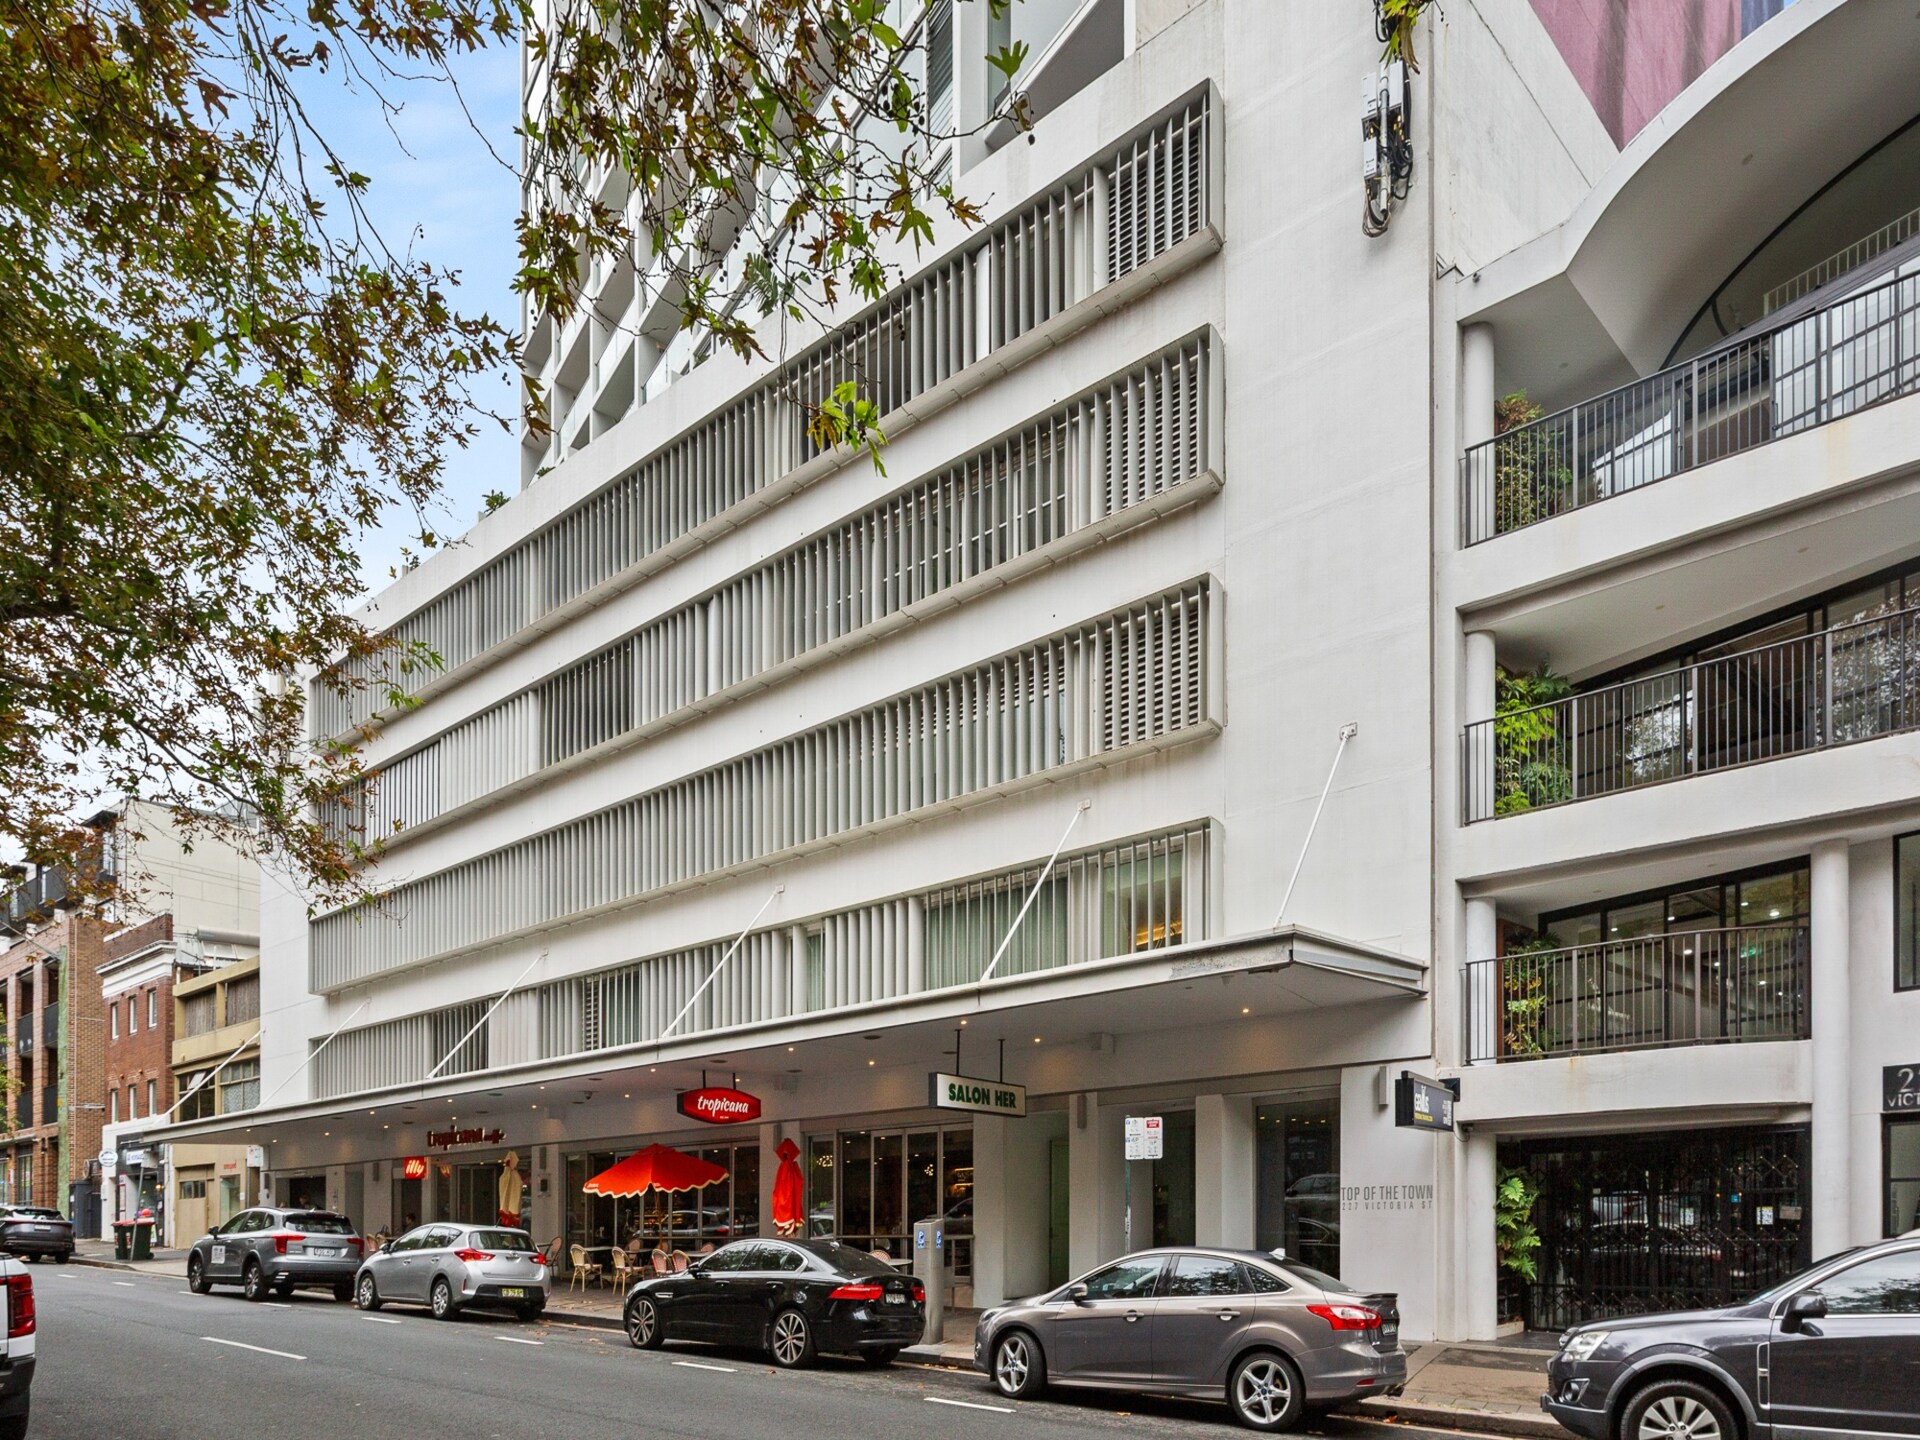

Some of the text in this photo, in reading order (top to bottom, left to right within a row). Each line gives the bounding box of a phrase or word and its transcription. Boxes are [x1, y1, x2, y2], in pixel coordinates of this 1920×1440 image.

[1898, 1067, 1920, 1092] 2
[948, 1083, 1016, 1108] SALON HER
[697, 1096, 749, 1117] tropicana
[406, 1159, 424, 1177] illy
[1341, 1184, 1433, 1201] TOP OF THE TOWN
[1342, 1200, 1433, 1211] 227 VICTORIA ST
